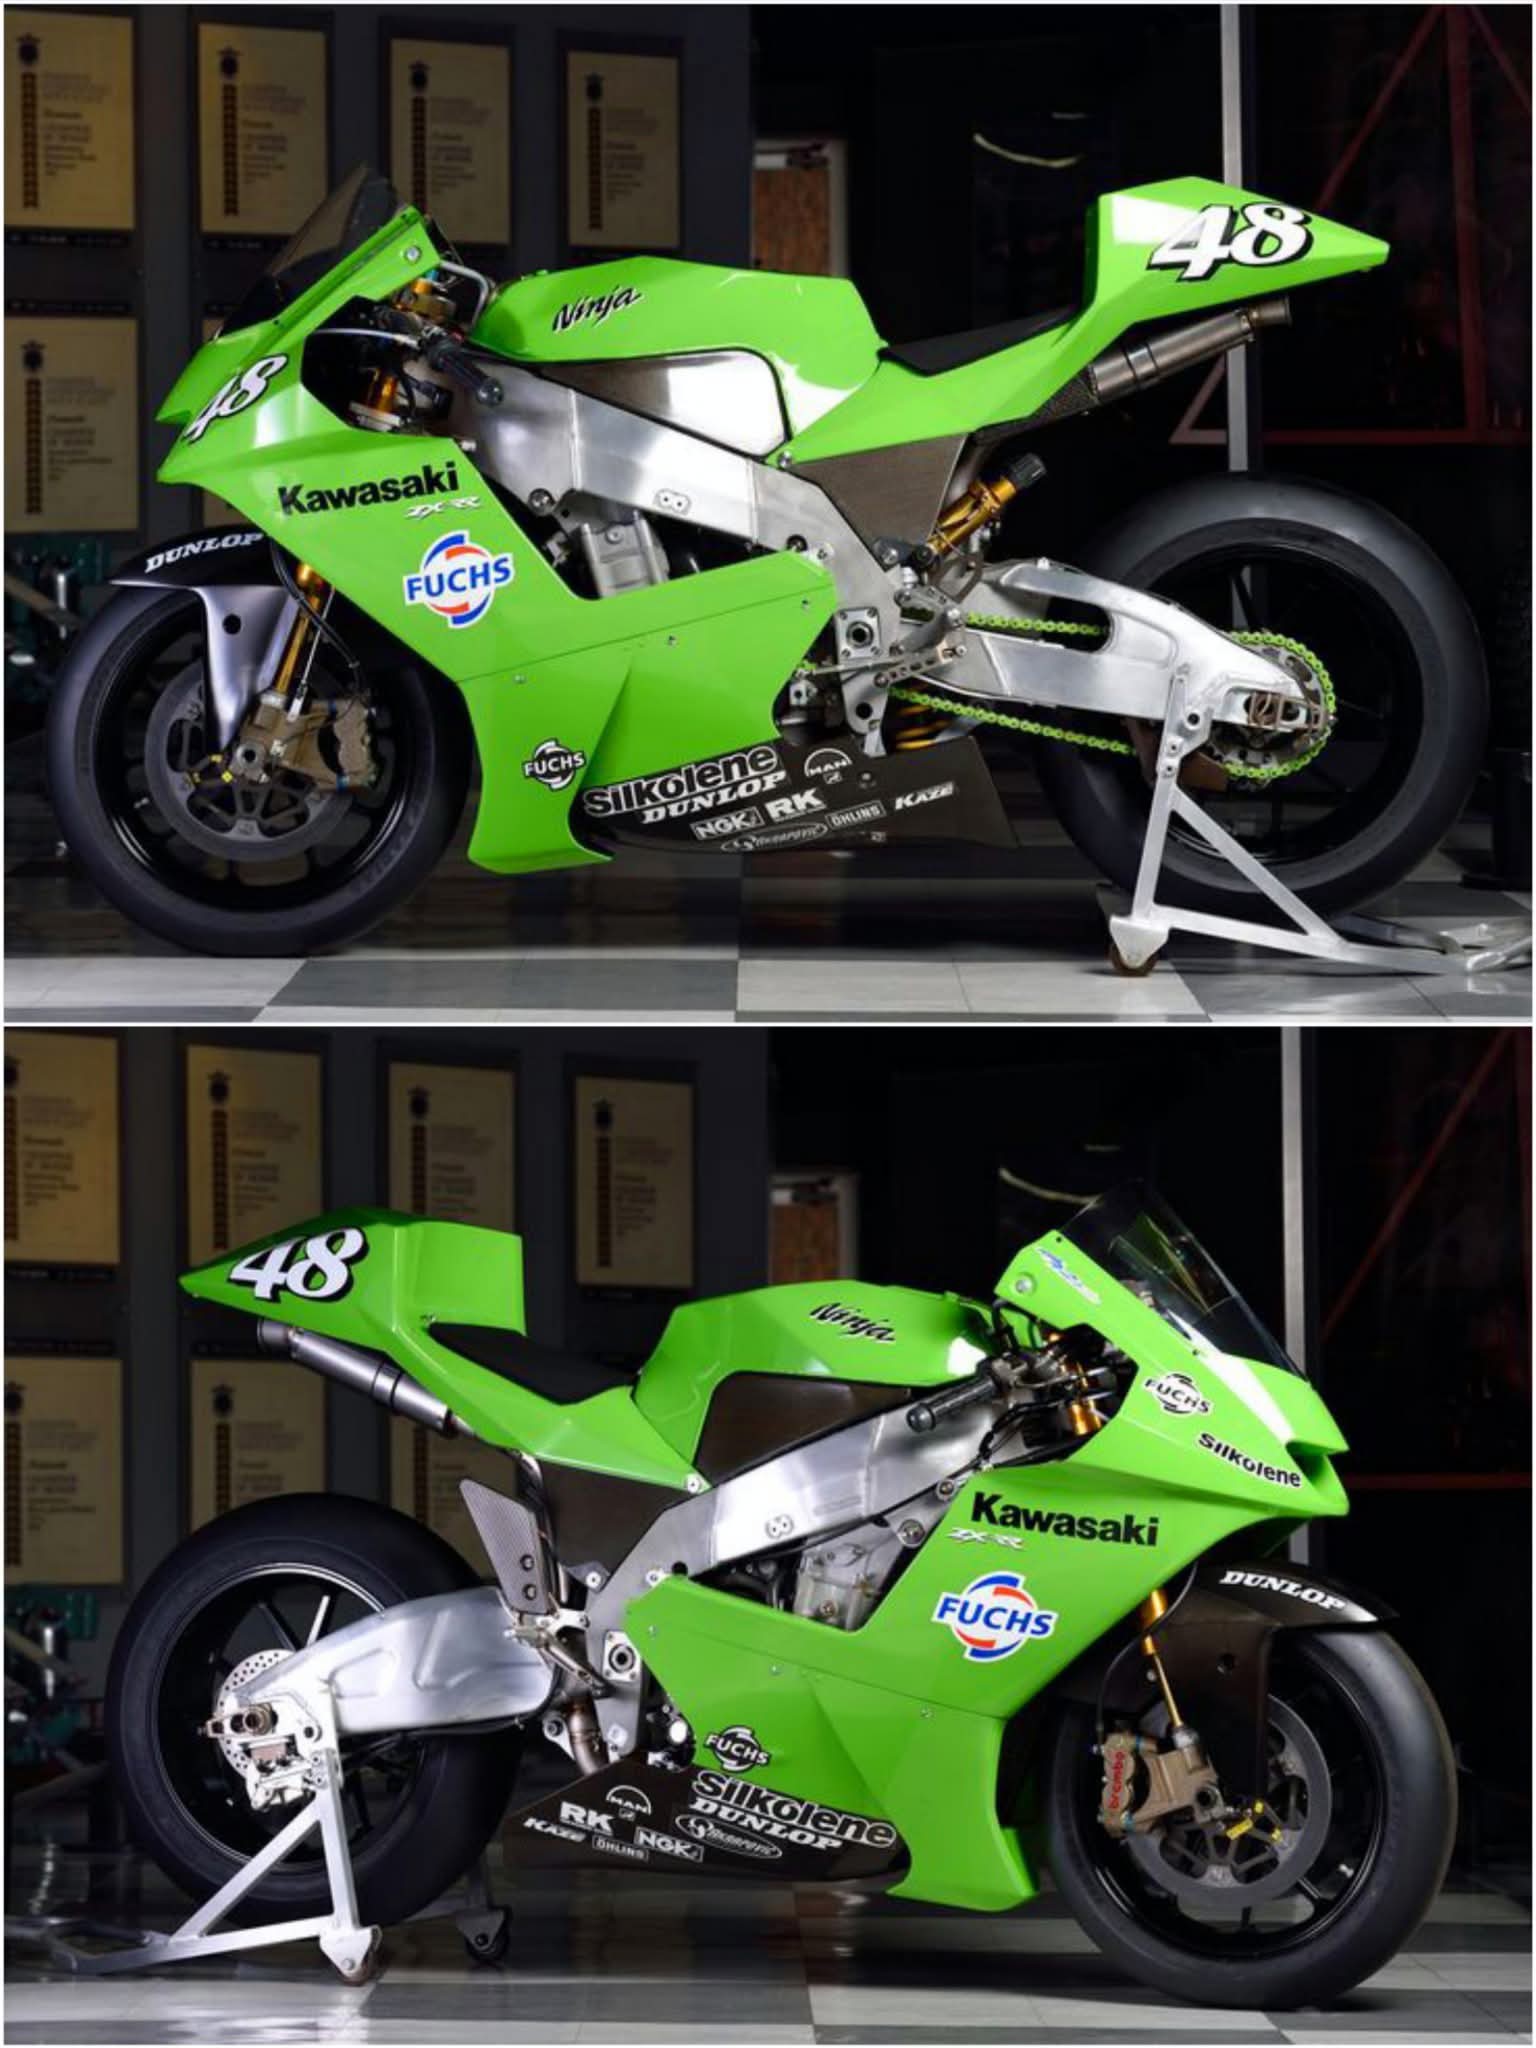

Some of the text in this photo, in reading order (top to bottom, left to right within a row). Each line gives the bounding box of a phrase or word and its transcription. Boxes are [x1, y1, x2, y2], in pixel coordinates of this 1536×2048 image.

[1147, 202, 1314, 282] 48
[551, 284, 643, 333] Ninja
[181, 353, 289, 446] 48
[278, 461, 460, 517] Kawasaki
[144, 532, 265, 574] DUNLOP
[406, 557, 511, 601] FUCHS
[524, 752, 585, 779] FUCHS
[583, 746, 779, 818] Silkolene
[808, 759, 851, 777] MAN
[639, 770, 788, 824] DUNLOP
[765, 788, 824, 820] RK
[894, 782, 955, 810] KAZE
[694, 812, 749, 838] NGK
[227, 1226, 369, 1303] 48
[808, 1301, 896, 1343] Ninja
[1144, 1378, 1212, 1414] FUCHS
[1198, 1432, 1302, 1487] Silkolene
[970, 1491, 1160, 1547] Kawasaki
[1219, 1570, 1346, 1610] DUNLOP
[937, 1595, 1054, 1638] FUCHS
[705, 1733, 771, 1767] FUCHS
[559, 1801, 615, 1835] RK
[609, 1796, 650, 1815] MAN
[688, 1799, 843, 1850] DUNLOP
[692, 1769, 898, 1849] Silkolene
[638, 1830, 699, 1860] NGK
